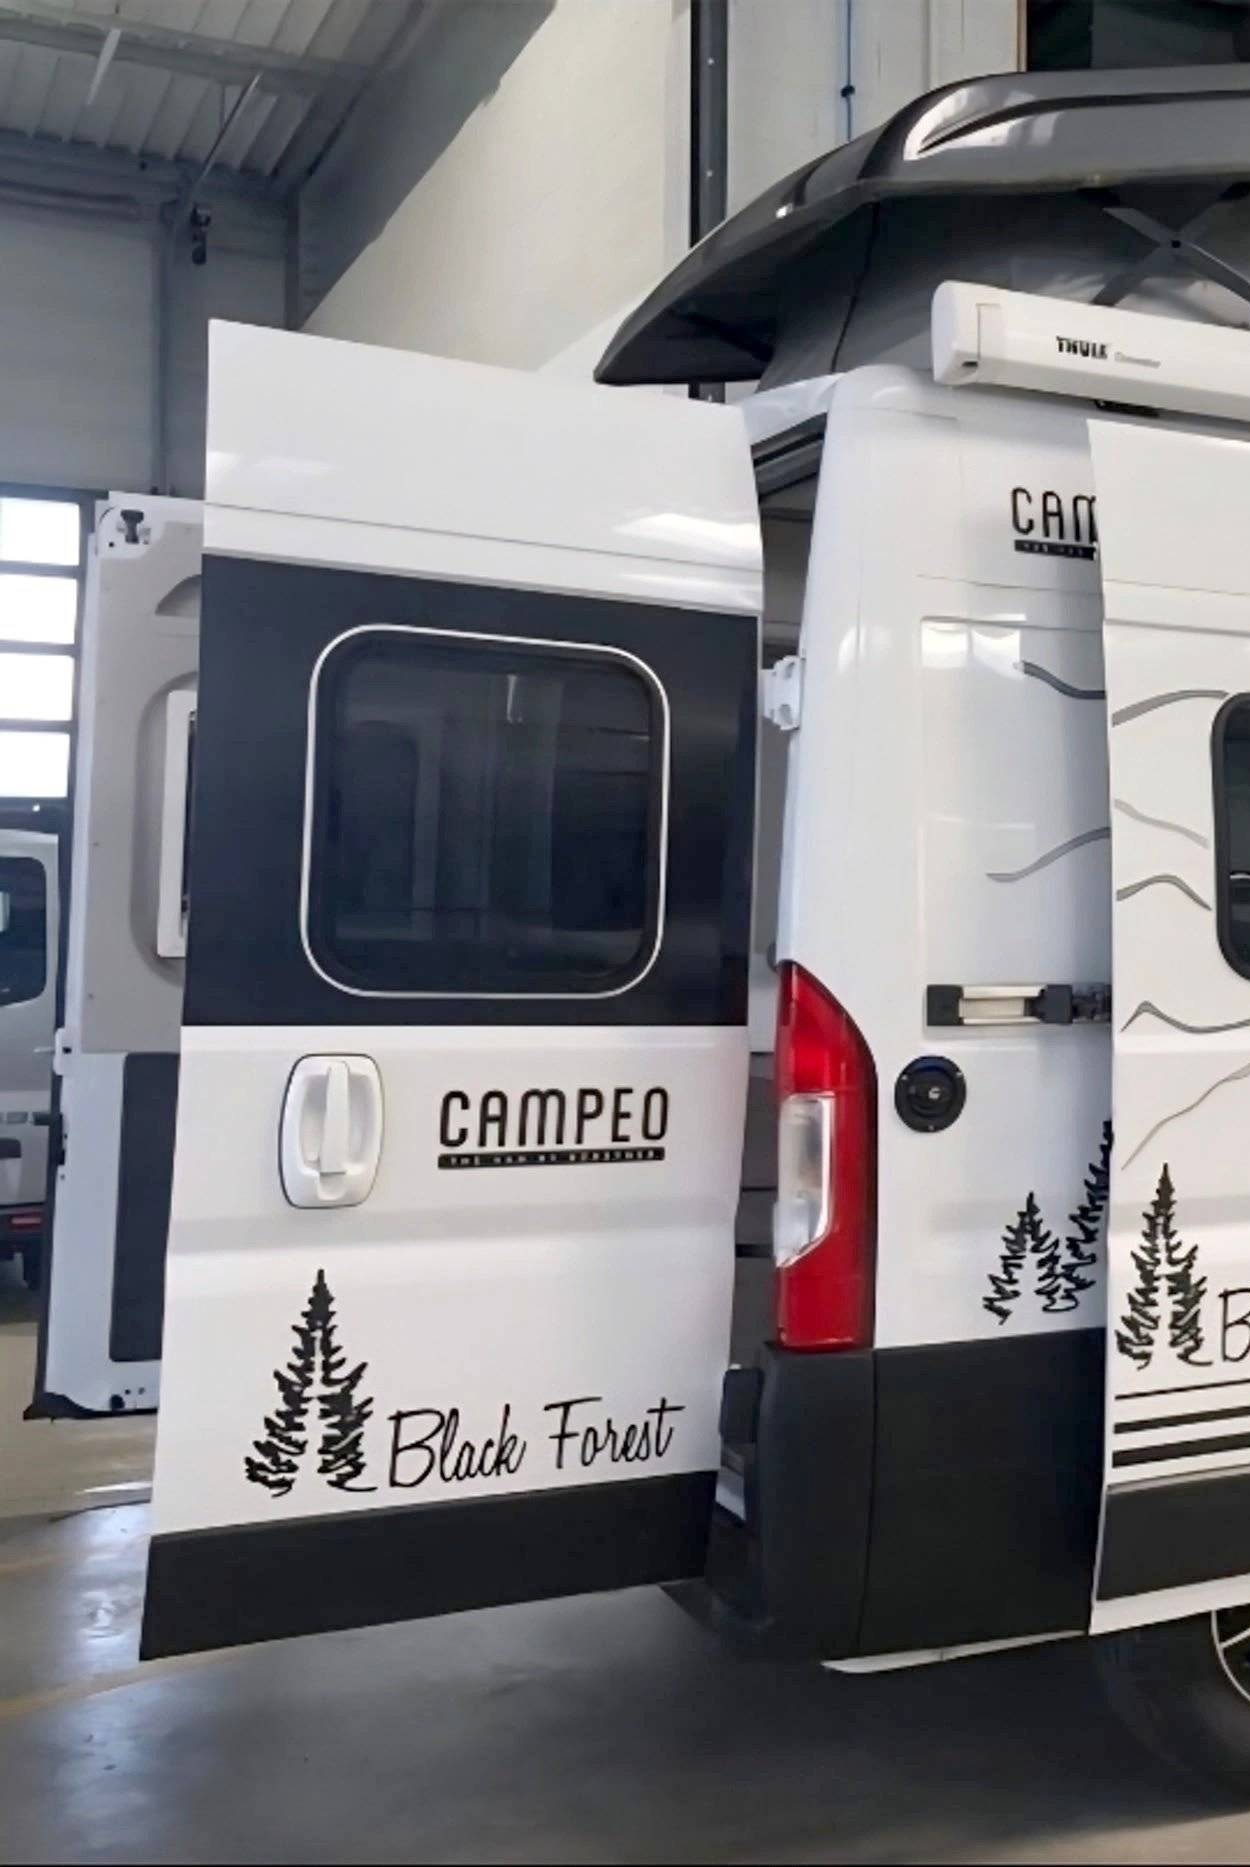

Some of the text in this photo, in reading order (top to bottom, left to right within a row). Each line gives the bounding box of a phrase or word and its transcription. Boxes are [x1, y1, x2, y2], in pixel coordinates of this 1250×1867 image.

[1056, 335, 1111, 360] THULE
[439, 1086, 669, 1148] CAMPEO
[387, 1397, 685, 1487] Black Forest
